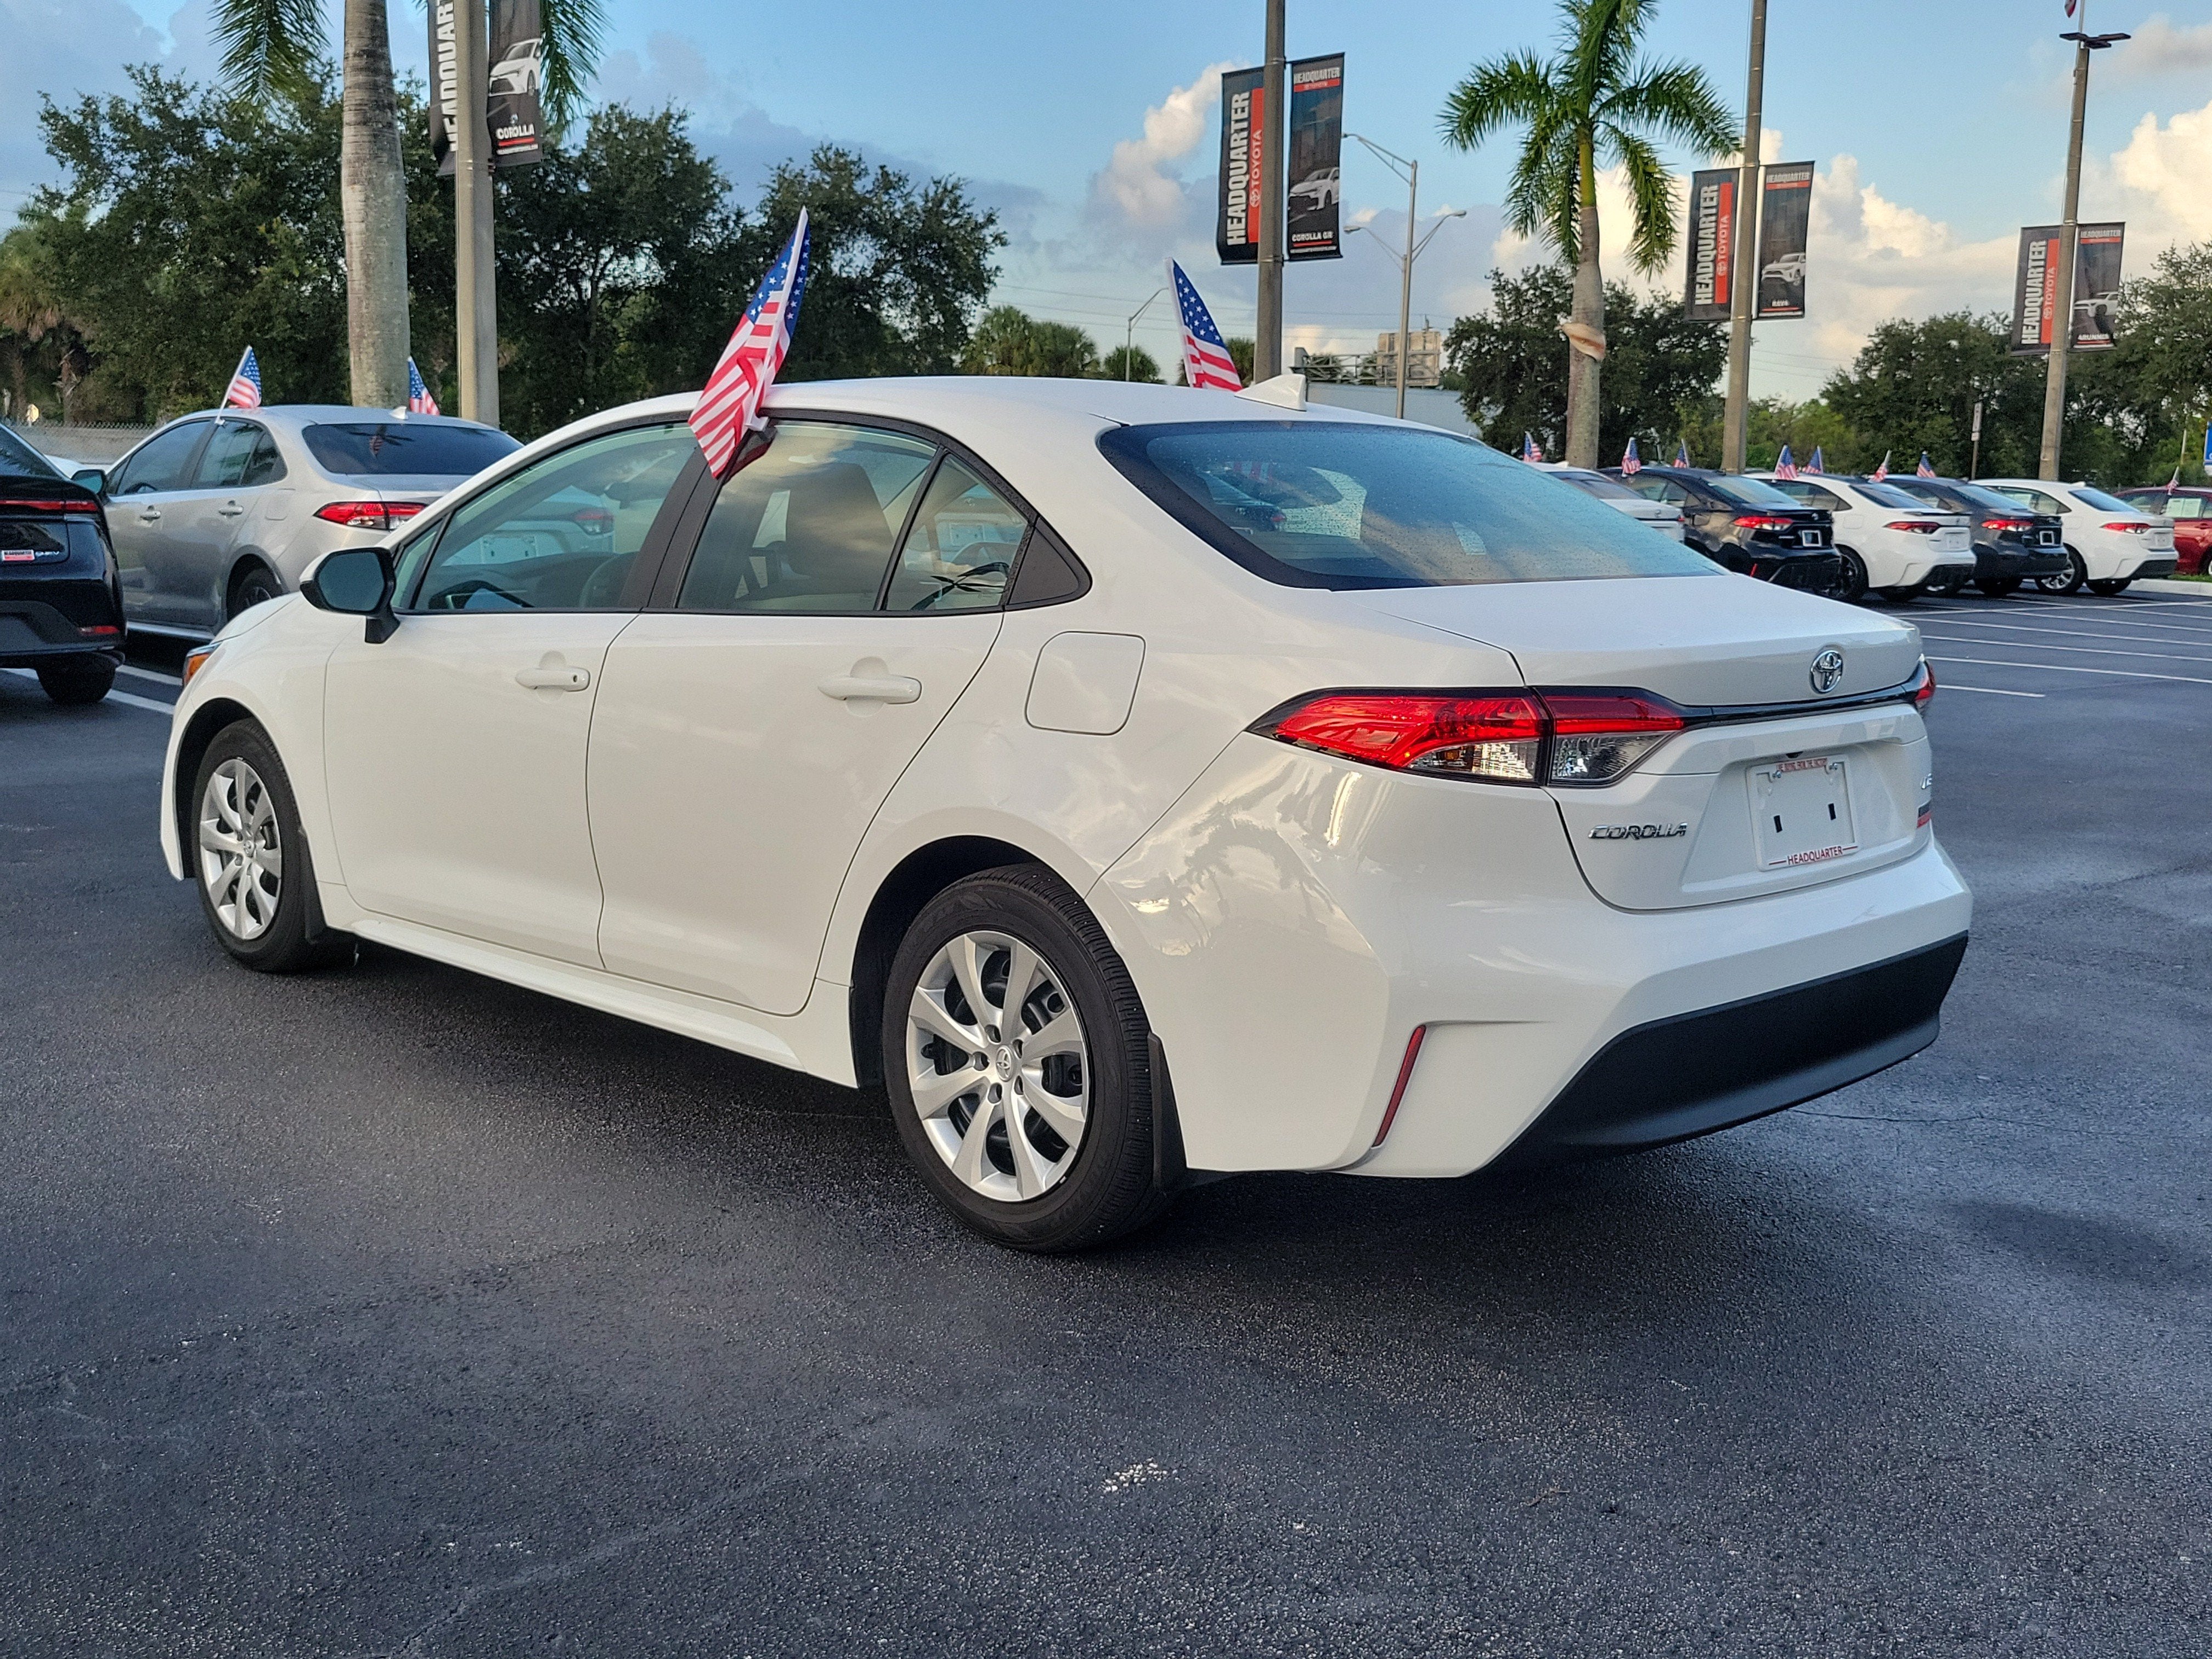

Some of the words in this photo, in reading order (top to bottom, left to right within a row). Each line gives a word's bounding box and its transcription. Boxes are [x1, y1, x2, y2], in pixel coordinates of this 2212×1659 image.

[1294, 67, 1340, 84] HEADQUARTER
[495, 123, 535, 139] COROLLA
[1227, 92, 1250, 245] HEADQUARTER
[1251, 129, 1262, 188] TOYOTA
[1292, 232, 1322, 242] COROLLA
[1695, 185, 1719, 306] HEADQUARTER
[1717, 215, 1729, 260] TOYOTA
[2021, 240, 2047, 344] HEADQUARTER
[2045, 267, 2056, 305] TOYOTA
[1588, 821, 1688, 840] COROLLA
[1787, 846, 1843, 865] HEADQUARTER
